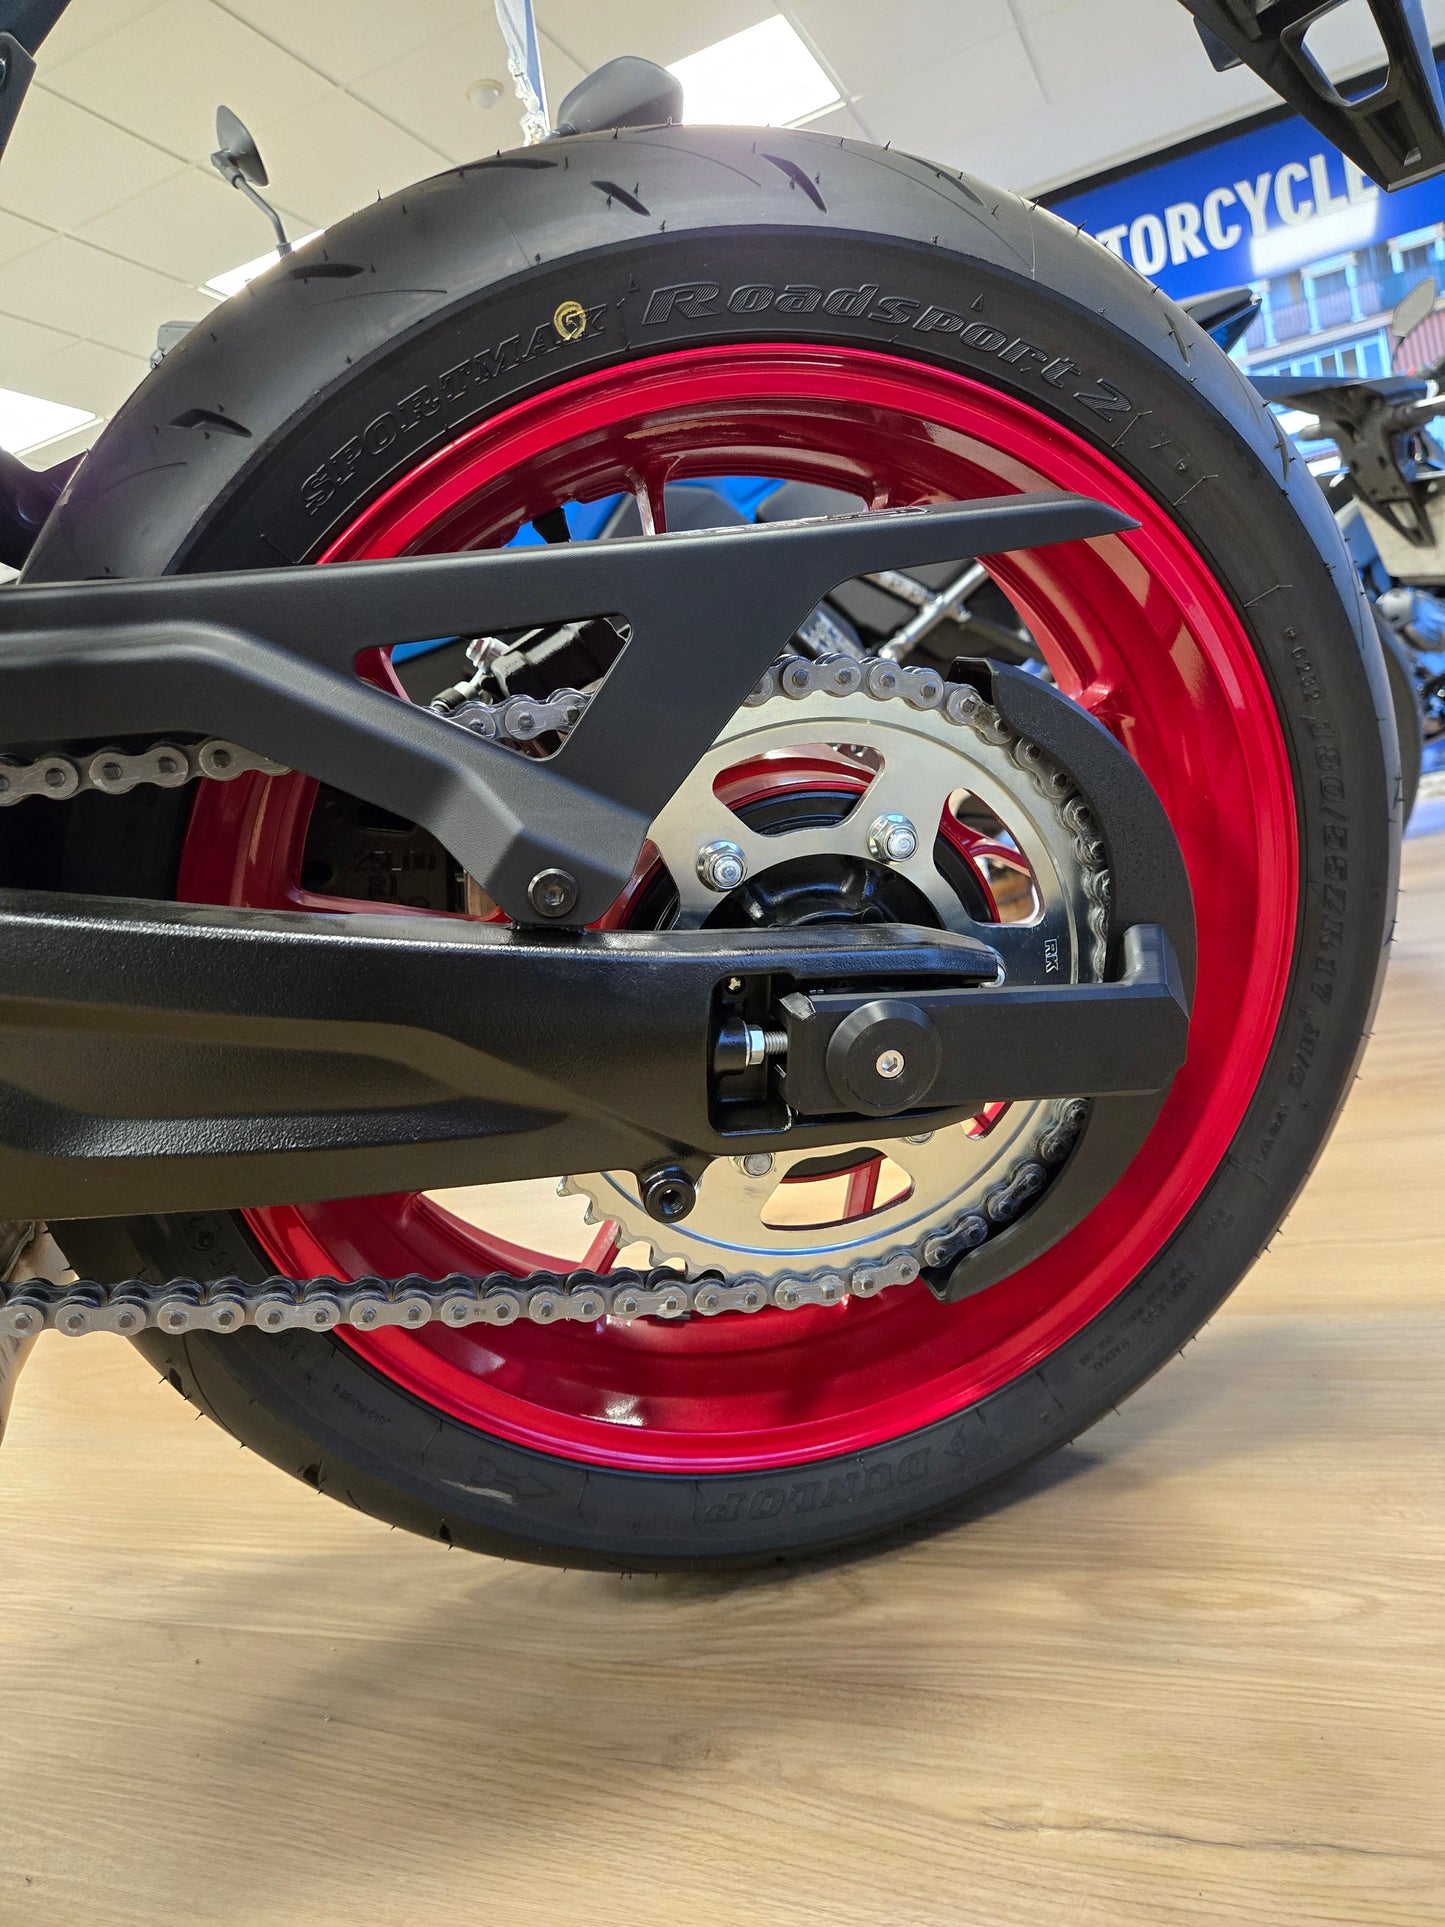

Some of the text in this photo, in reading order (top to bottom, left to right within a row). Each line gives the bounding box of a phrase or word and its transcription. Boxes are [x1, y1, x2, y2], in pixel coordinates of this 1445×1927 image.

[299, 279, 1136, 516] SPORTMAX Roadsport 2
[1043, 938, 1060, 974] RK
[704, 1448, 931, 1523] DUNLOP
